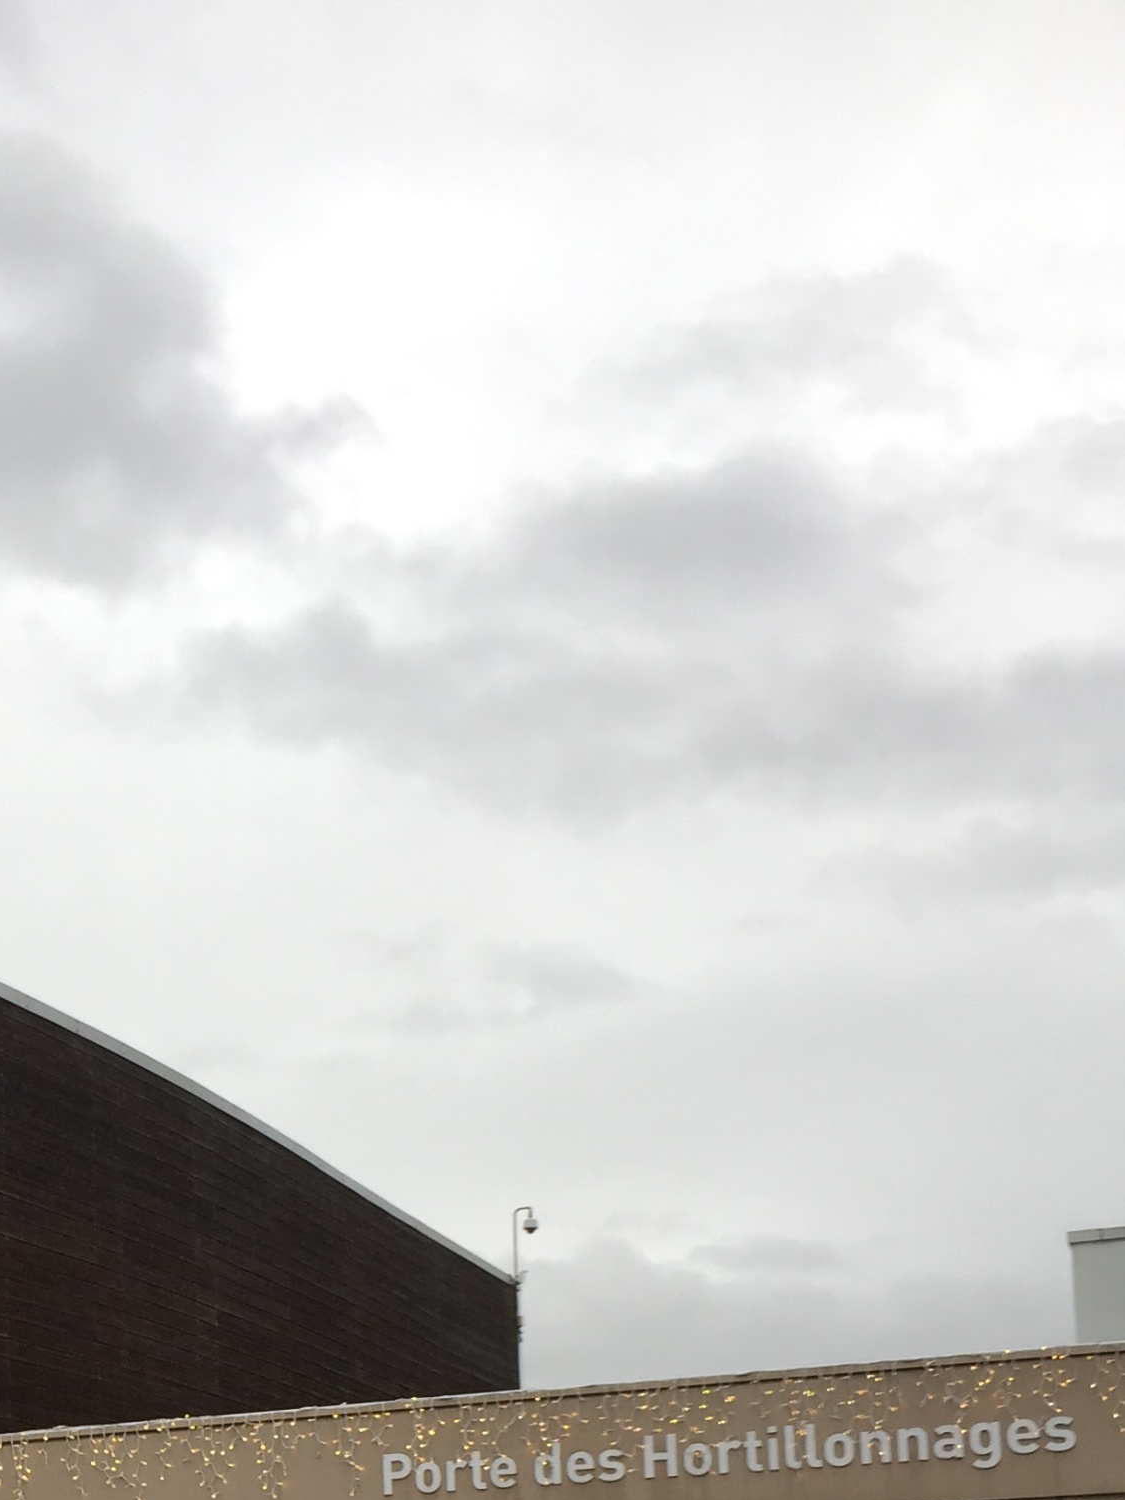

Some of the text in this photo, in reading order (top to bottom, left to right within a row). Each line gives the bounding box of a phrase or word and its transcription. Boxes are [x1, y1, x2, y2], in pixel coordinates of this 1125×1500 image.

[382, 1414, 1077, 1496] Porte des Hortillonnages
